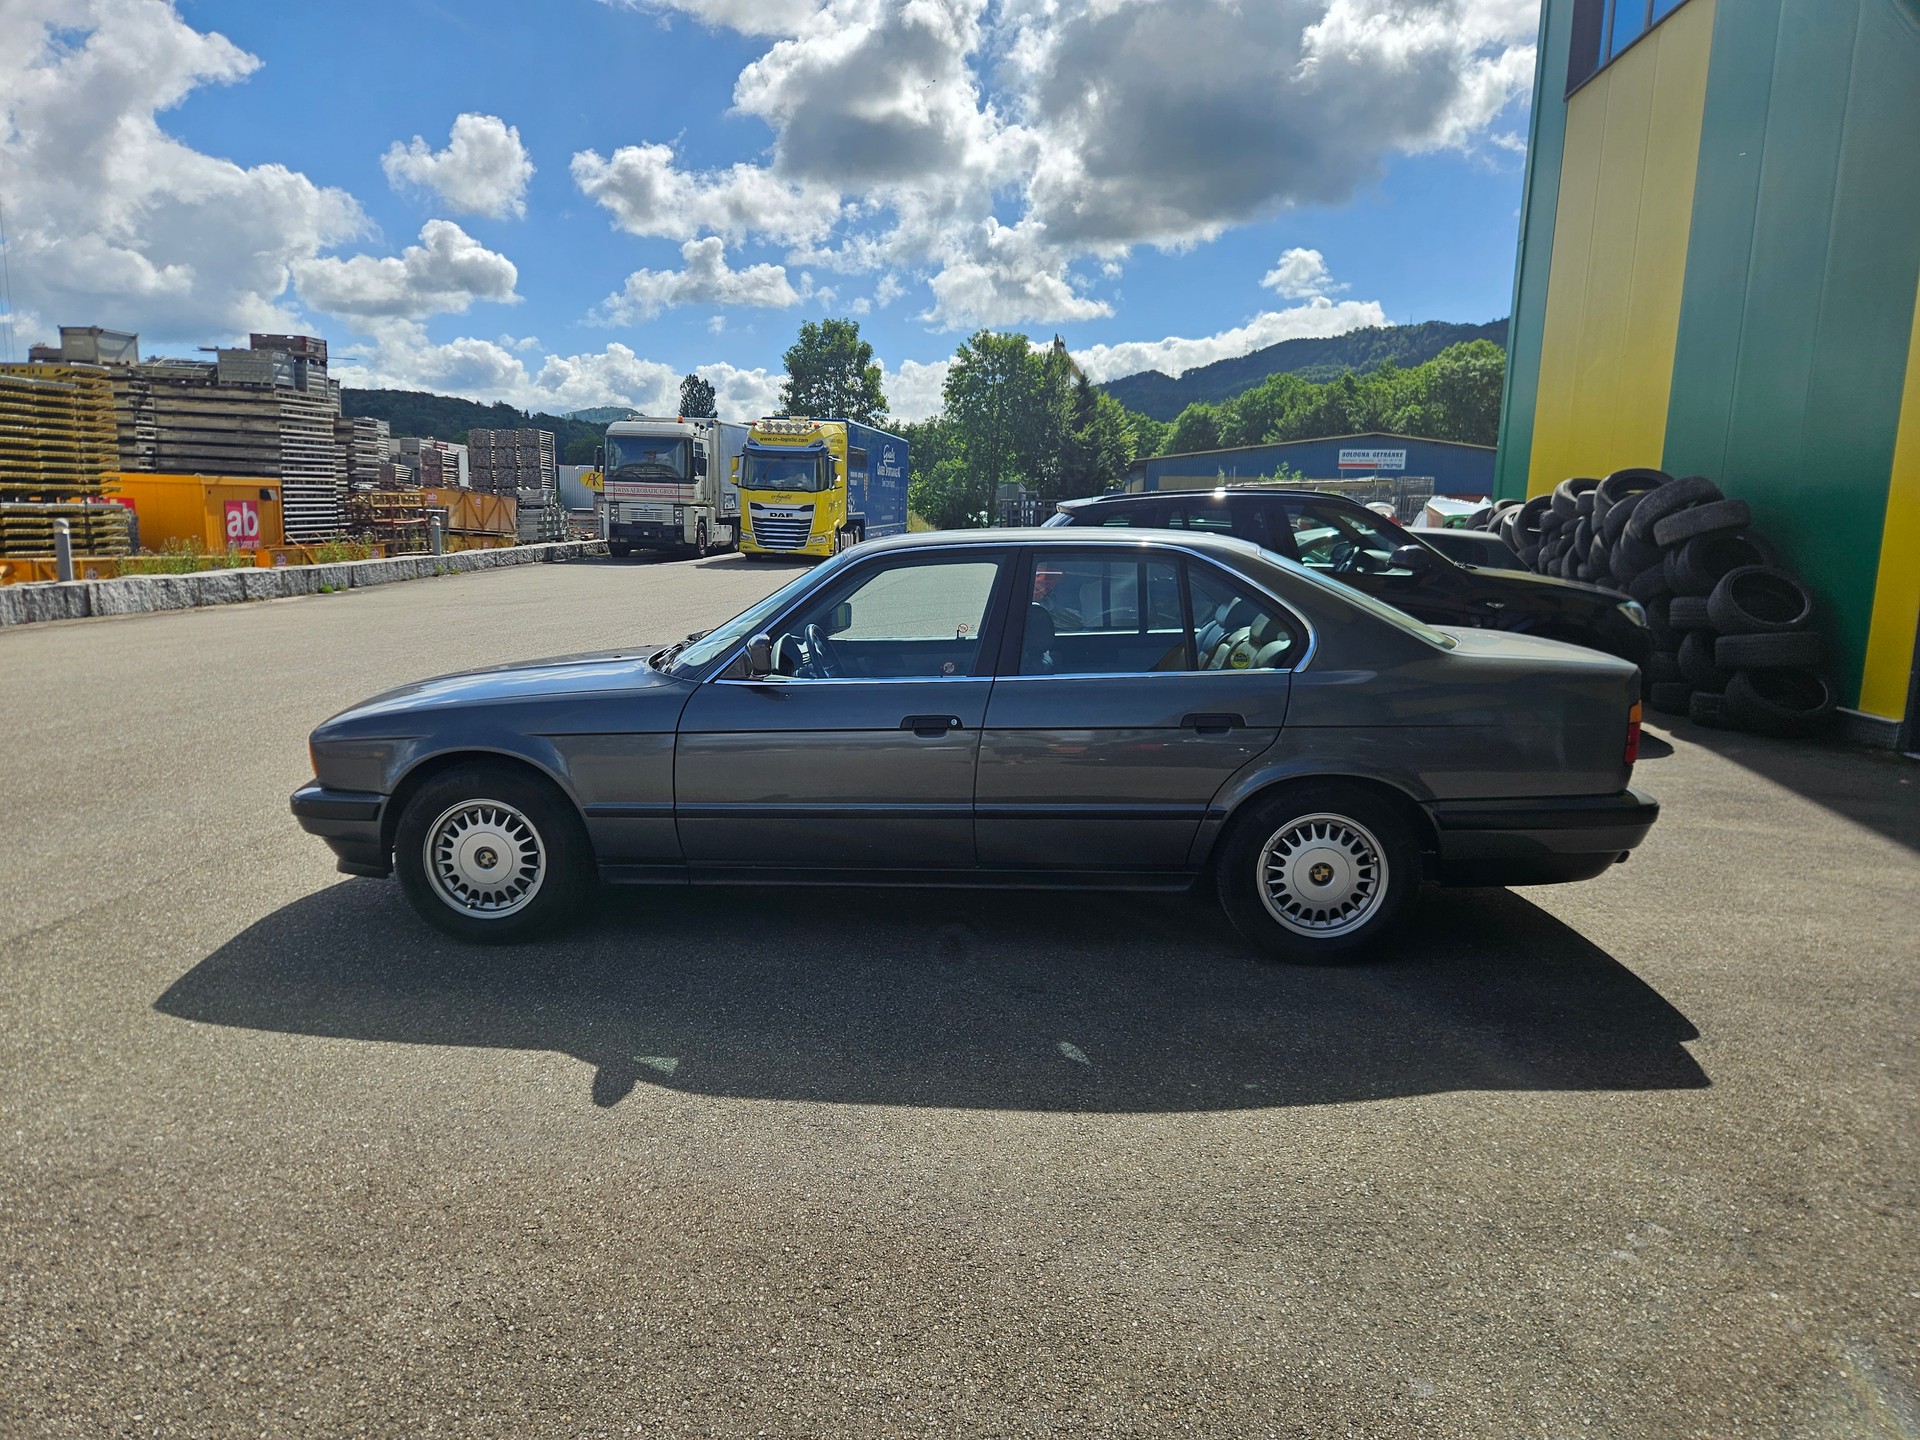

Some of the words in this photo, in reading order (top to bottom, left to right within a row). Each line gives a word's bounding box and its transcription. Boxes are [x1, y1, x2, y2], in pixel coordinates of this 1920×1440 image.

[630, 487, 659, 495] AEROBATIC
[227, 502, 259, 538] ab
[276, 553, 287, 565] ab
